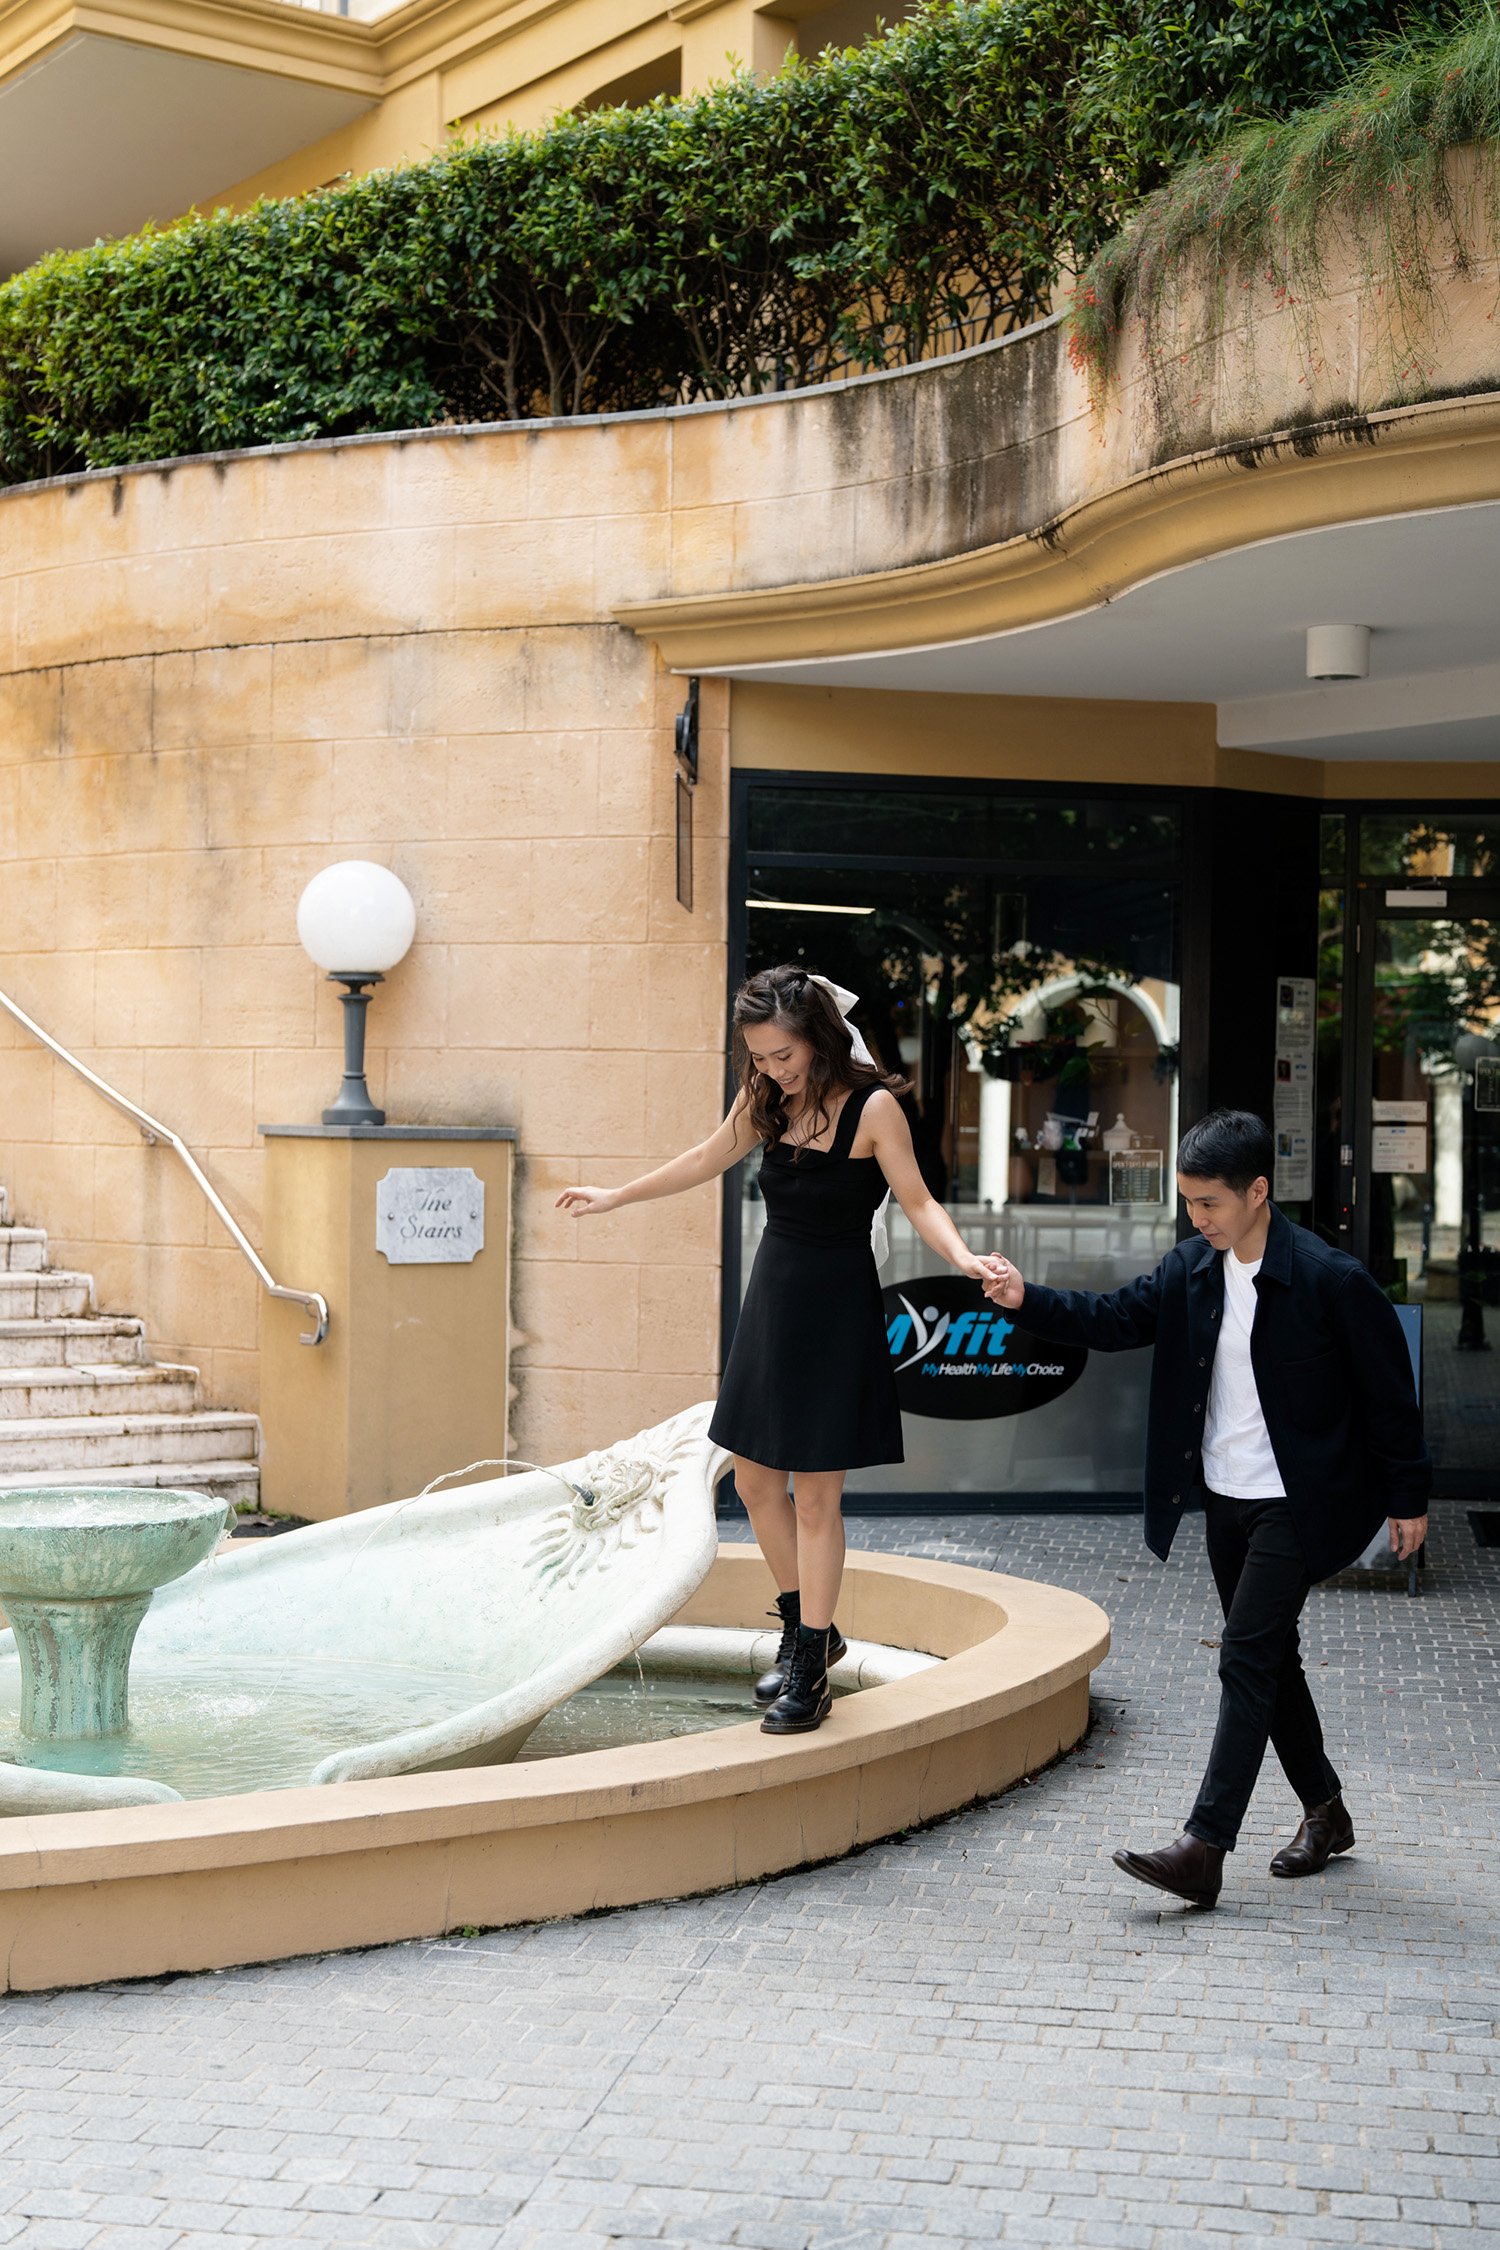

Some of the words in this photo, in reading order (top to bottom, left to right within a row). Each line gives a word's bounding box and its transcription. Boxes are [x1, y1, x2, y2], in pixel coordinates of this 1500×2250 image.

[1112, 1160, 1124, 1169] OPEN
[415, 1187, 452, 1211] The
[400, 1213, 463, 1239] Stairs
